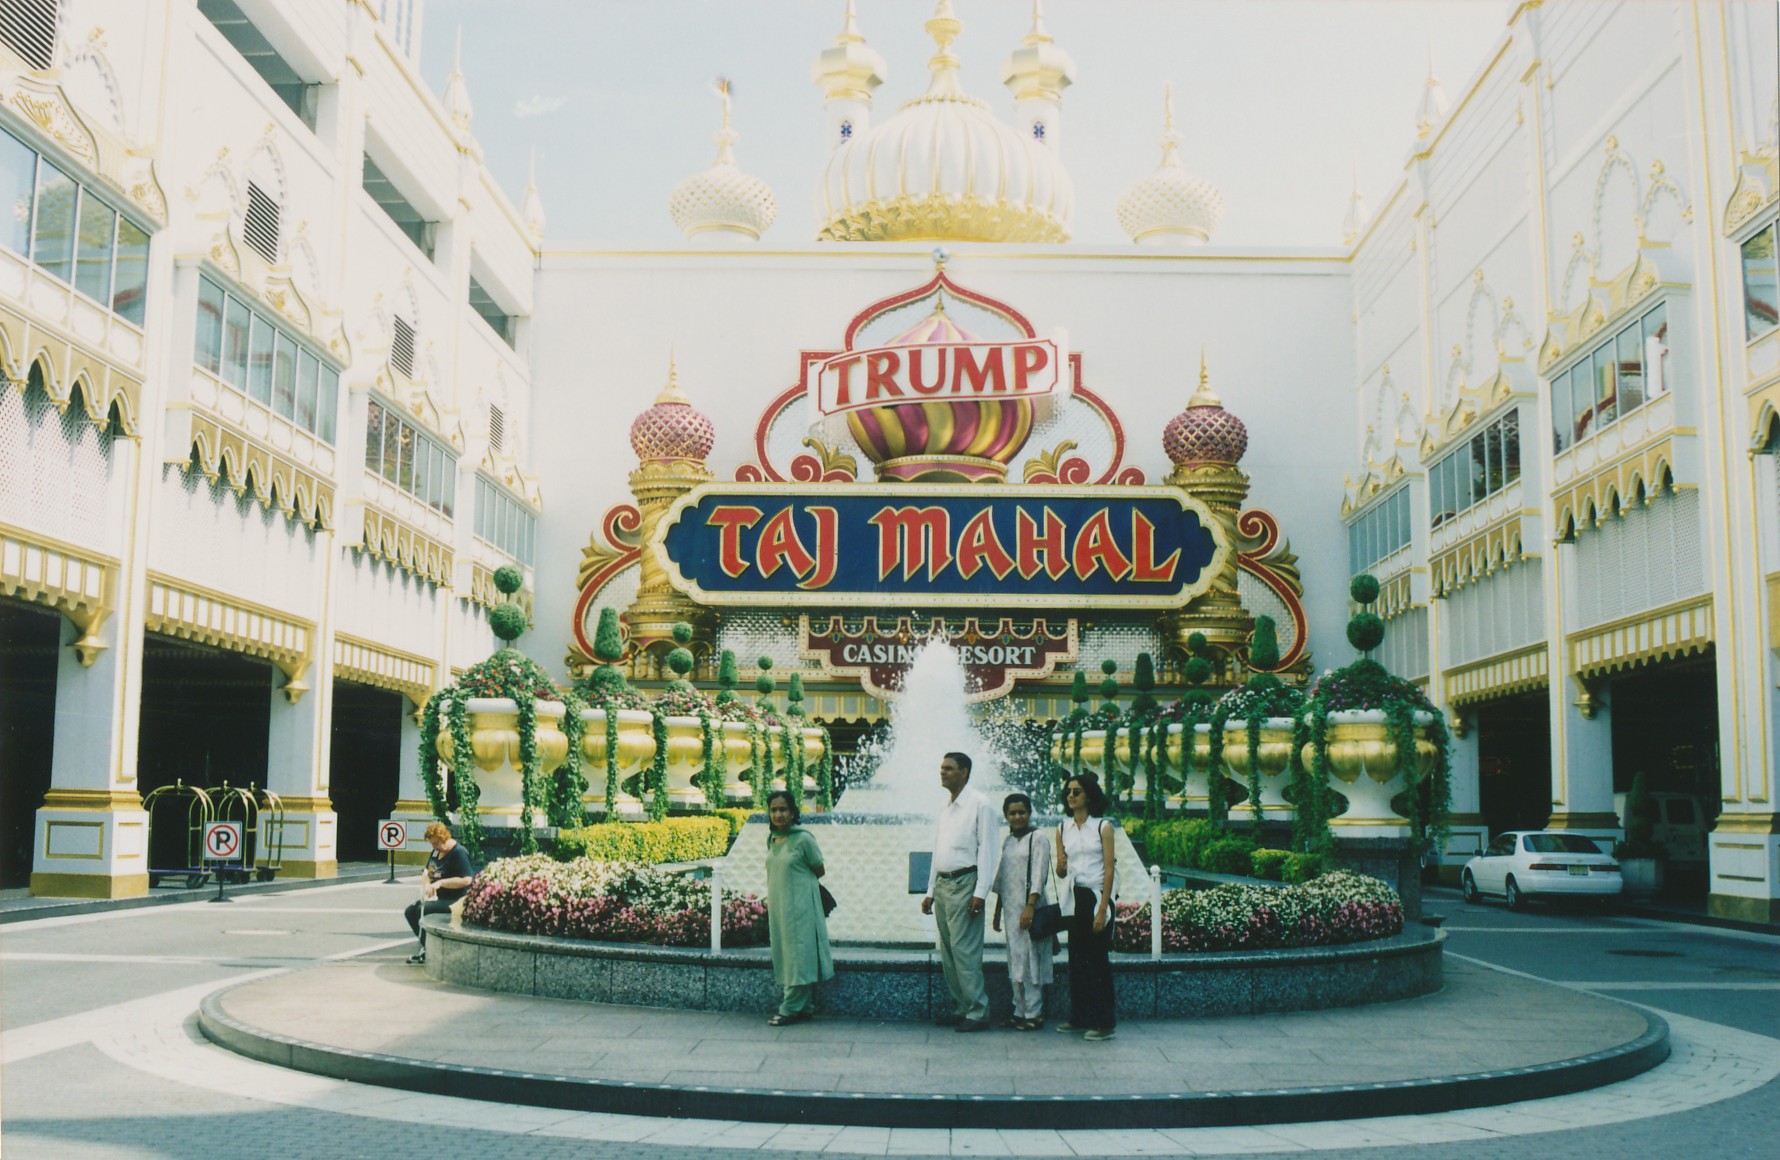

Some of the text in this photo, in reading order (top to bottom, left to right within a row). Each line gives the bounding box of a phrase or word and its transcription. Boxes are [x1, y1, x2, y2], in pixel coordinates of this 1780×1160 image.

[827, 344, 1050, 404] TRUMP
[707, 504, 1182, 589] TAJ MAHAL
[843, 644, 1037, 666] CASIN ESORT
[216, 831, 230, 850] P
[388, 827, 398, 842] P
